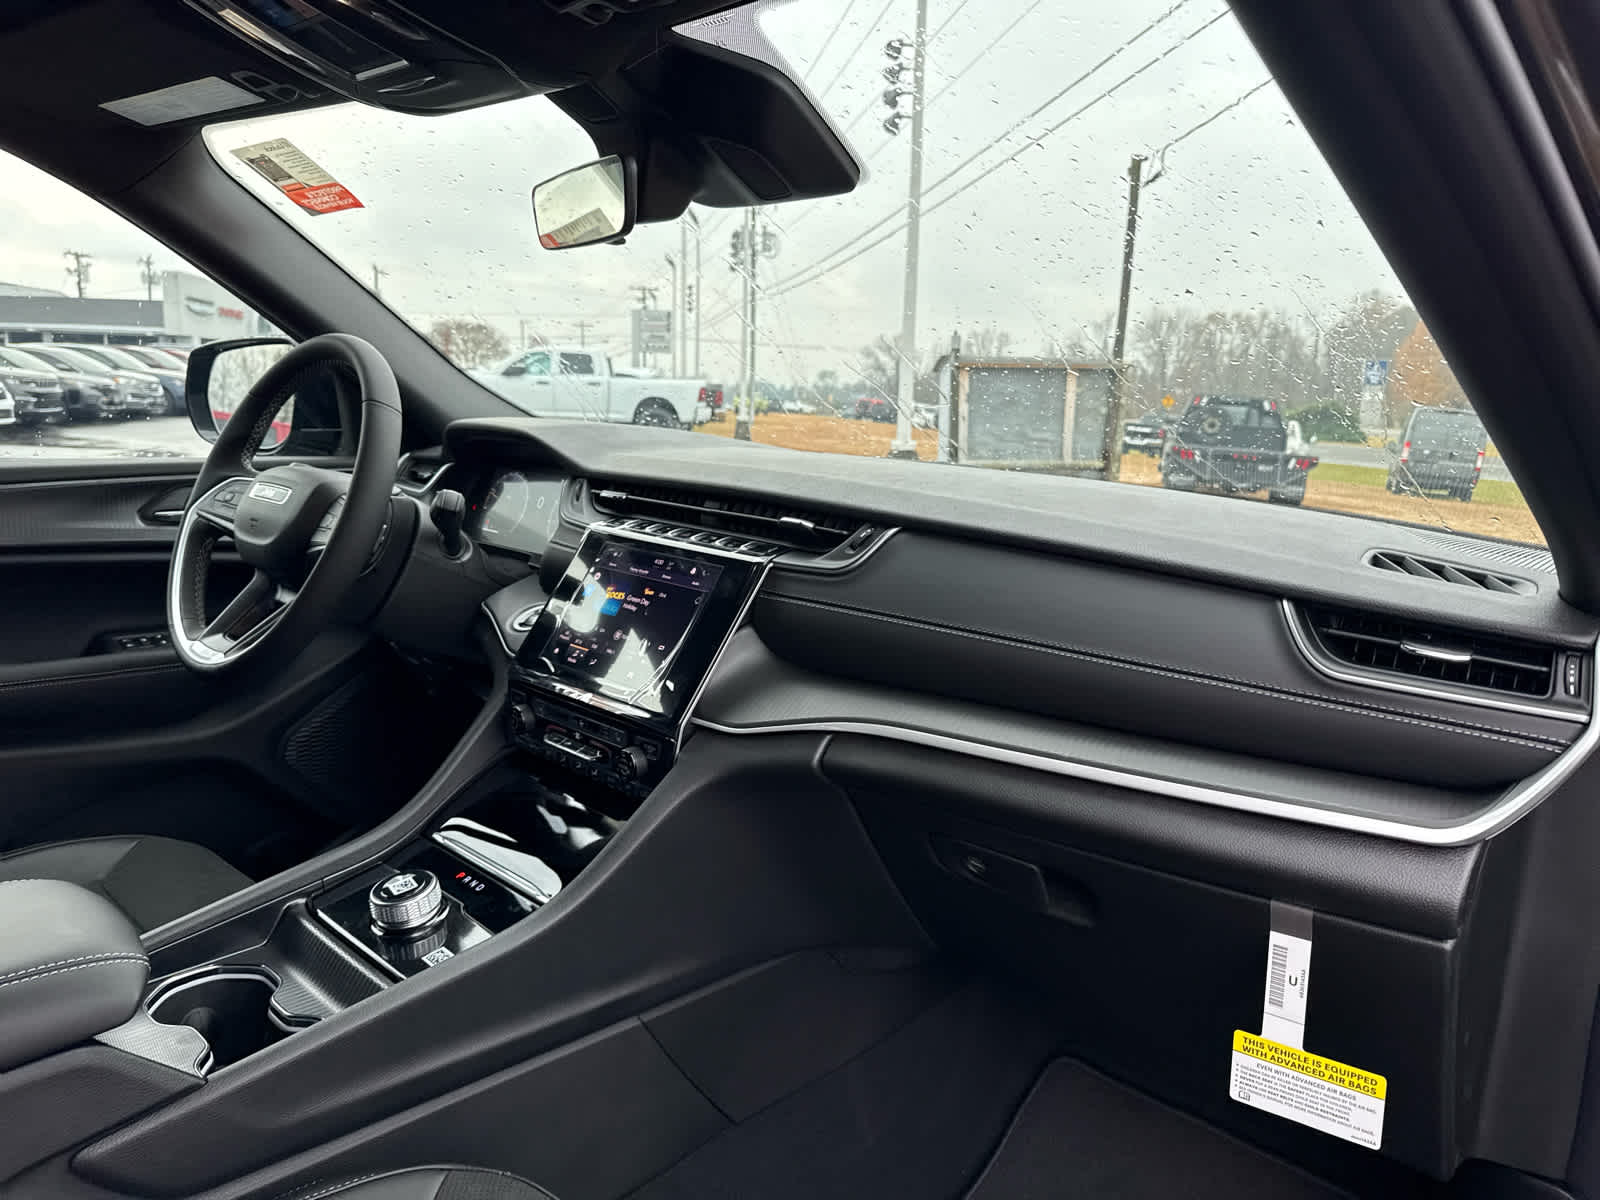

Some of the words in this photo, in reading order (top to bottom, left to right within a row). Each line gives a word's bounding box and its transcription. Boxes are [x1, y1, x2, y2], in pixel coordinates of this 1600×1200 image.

[1288, 975, 1297, 986] U
[1242, 1036, 1264, 1049] THIS
[1267, 1044, 1309, 1064] VEHICLE
[1312, 1059, 1321, 1068] IS
[1324, 1063, 1377, 1086] EQUIPPED
[1242, 1044, 1267, 1059] WITH
[1269, 1053, 1325, 1078] ADVANCED
[1327, 1072, 1345, 1085] AIR
[1348, 1079, 1376, 1095] BAGS
[1256, 1062, 1272, 1072] EVEN
[1274, 1068, 1289, 1078] WITH
[1291, 1074, 1324, 1090] ADVANCED
[1327, 1086, 1337, 1095] AIR
[1339, 1090, 1356, 1101] BAGS
